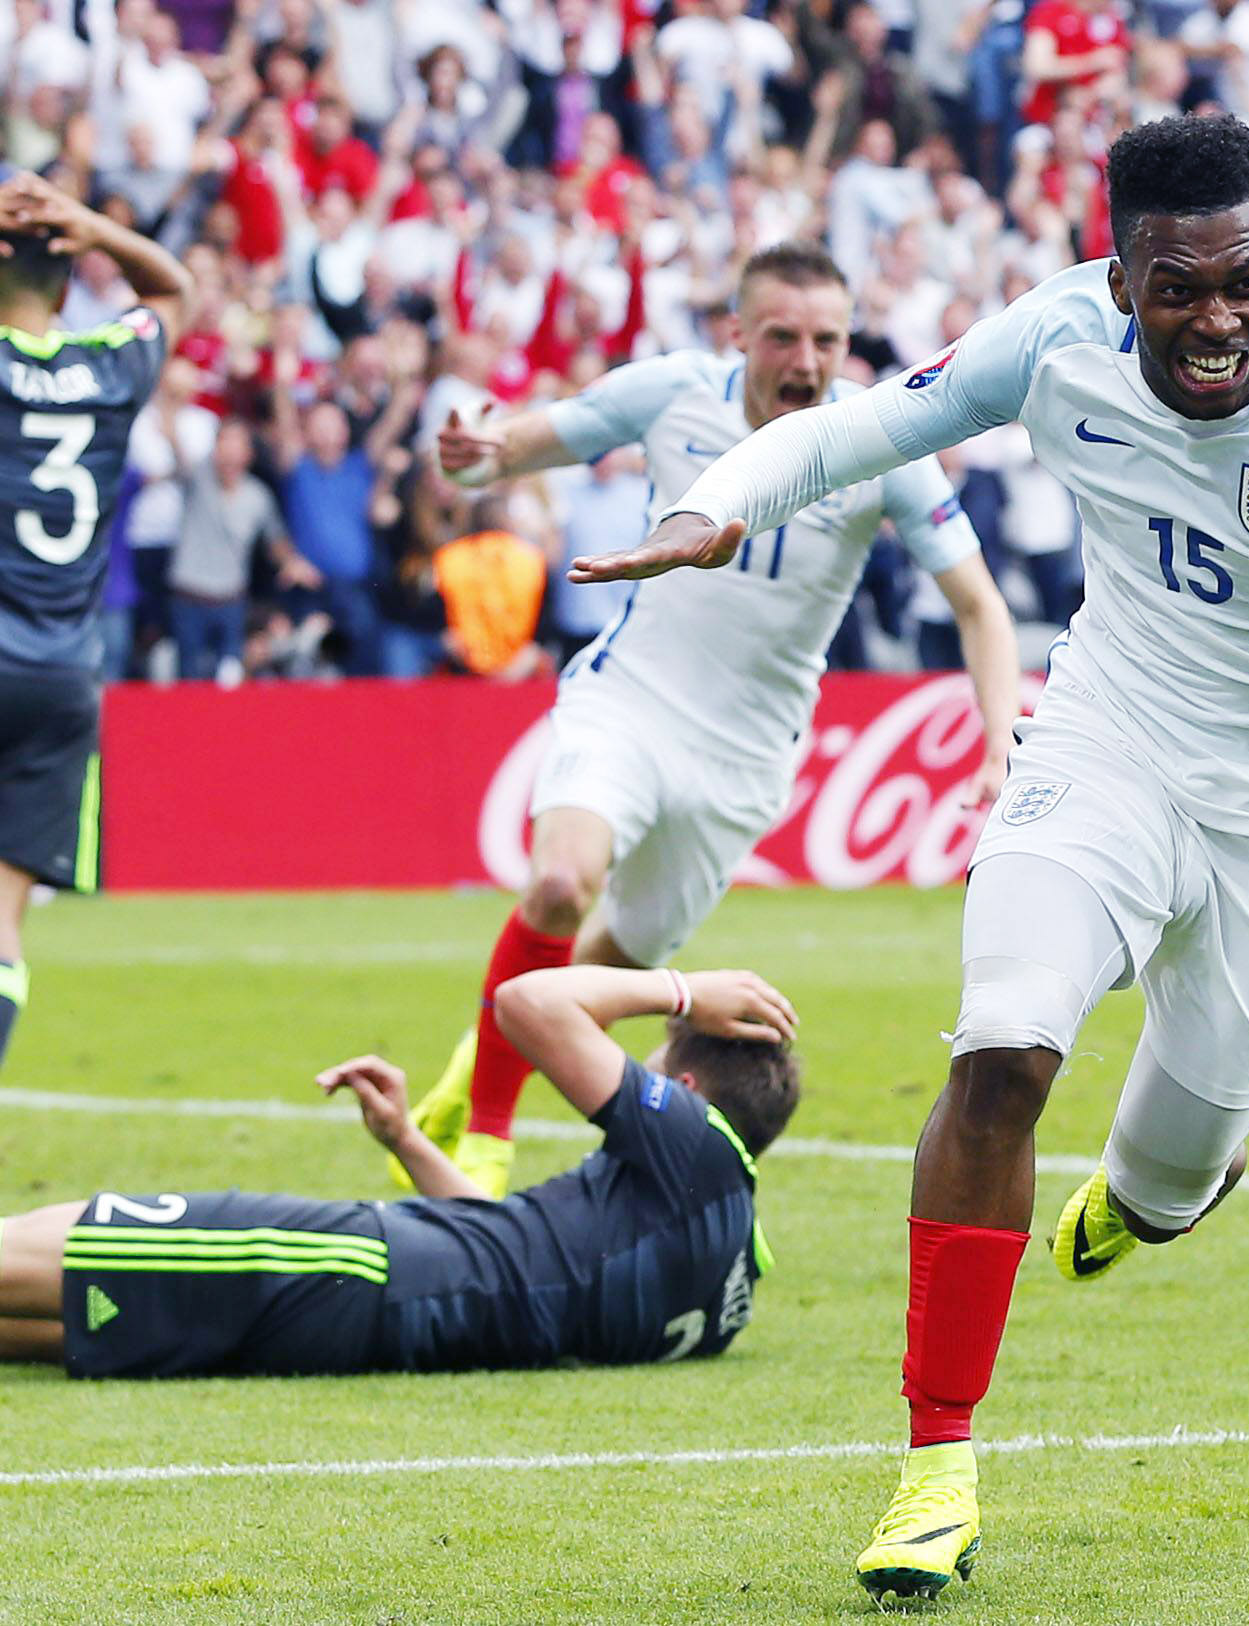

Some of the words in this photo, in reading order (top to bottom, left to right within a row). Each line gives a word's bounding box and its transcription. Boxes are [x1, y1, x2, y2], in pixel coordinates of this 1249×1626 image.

[14, 412, 100, 566] 3
[1148, 516, 1234, 605] 15
[94, 1191, 189, 1225] 2
